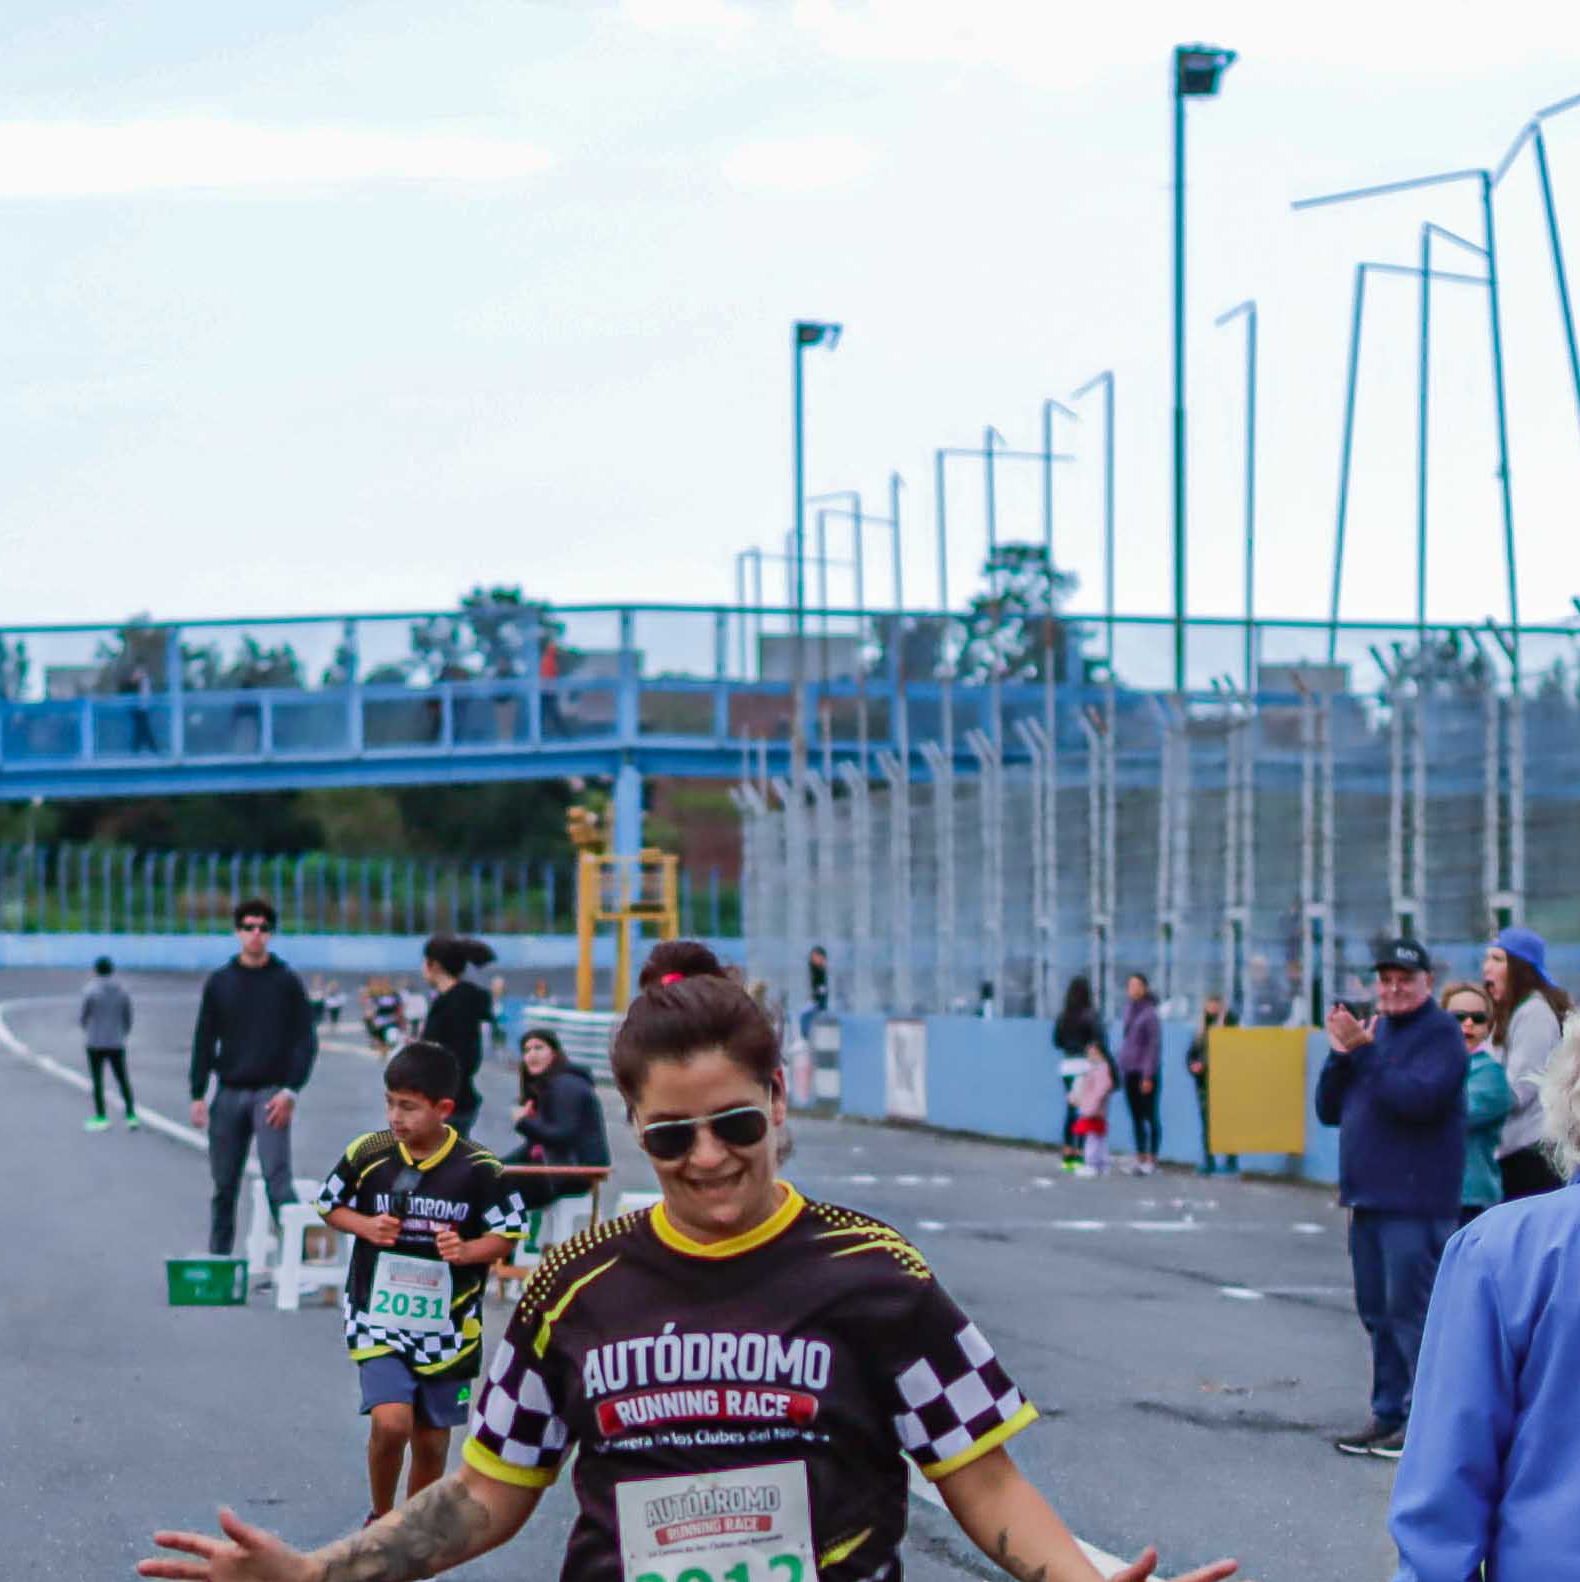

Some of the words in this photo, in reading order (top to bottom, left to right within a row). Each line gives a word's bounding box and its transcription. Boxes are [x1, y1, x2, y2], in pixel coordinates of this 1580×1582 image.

[373, 1289, 444, 1321] 2031
[583, 1321, 832, 1399] AUTÓDROMO
[614, 1389, 720, 1427] RUNNING
[725, 1389, 792, 1419] RACE
[645, 1484, 782, 1528] AUTÓDROMO
[666, 1519, 722, 1541] RUNNING
[724, 1516, 759, 1532] RACE
